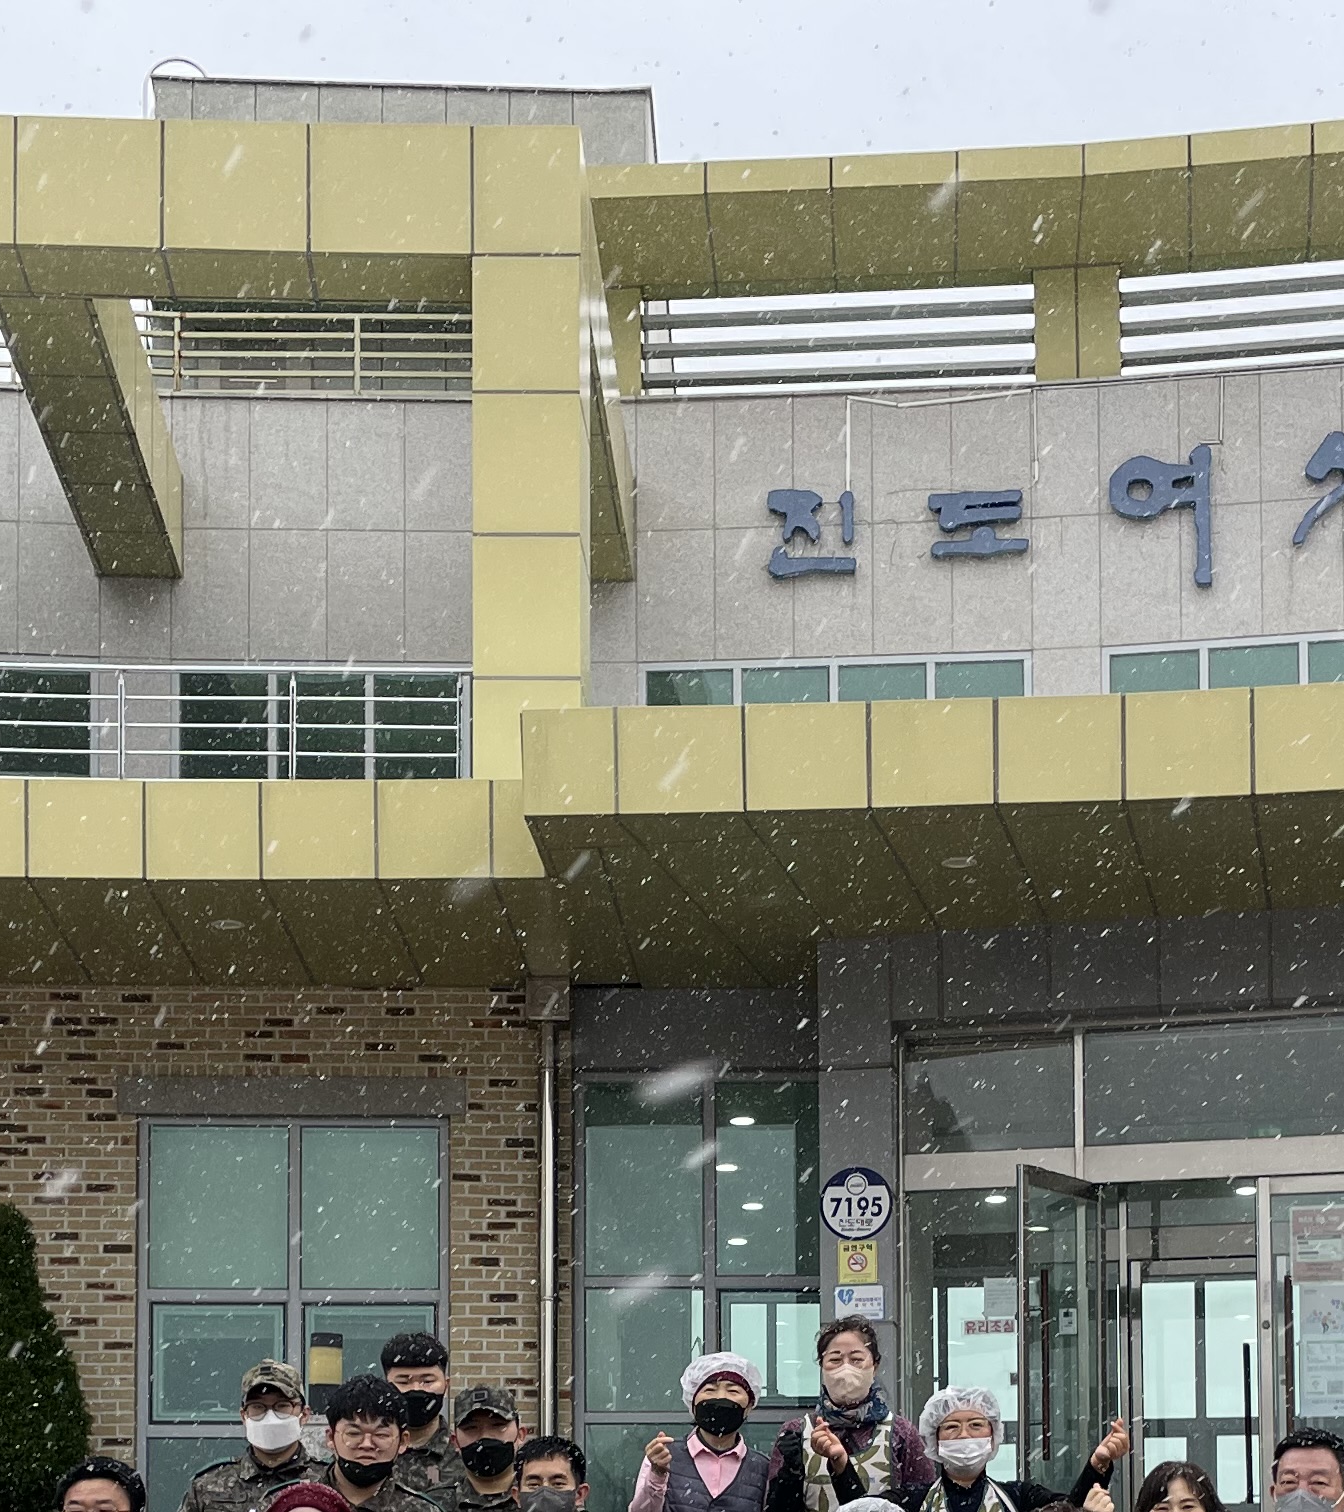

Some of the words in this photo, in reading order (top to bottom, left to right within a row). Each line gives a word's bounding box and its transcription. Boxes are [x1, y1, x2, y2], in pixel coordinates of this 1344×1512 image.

[830, 1196, 882, 1217] 7195
[842, 1243, 873, 1252] 금연구역
[965, 1320, 1015, 1334] 유리조심
